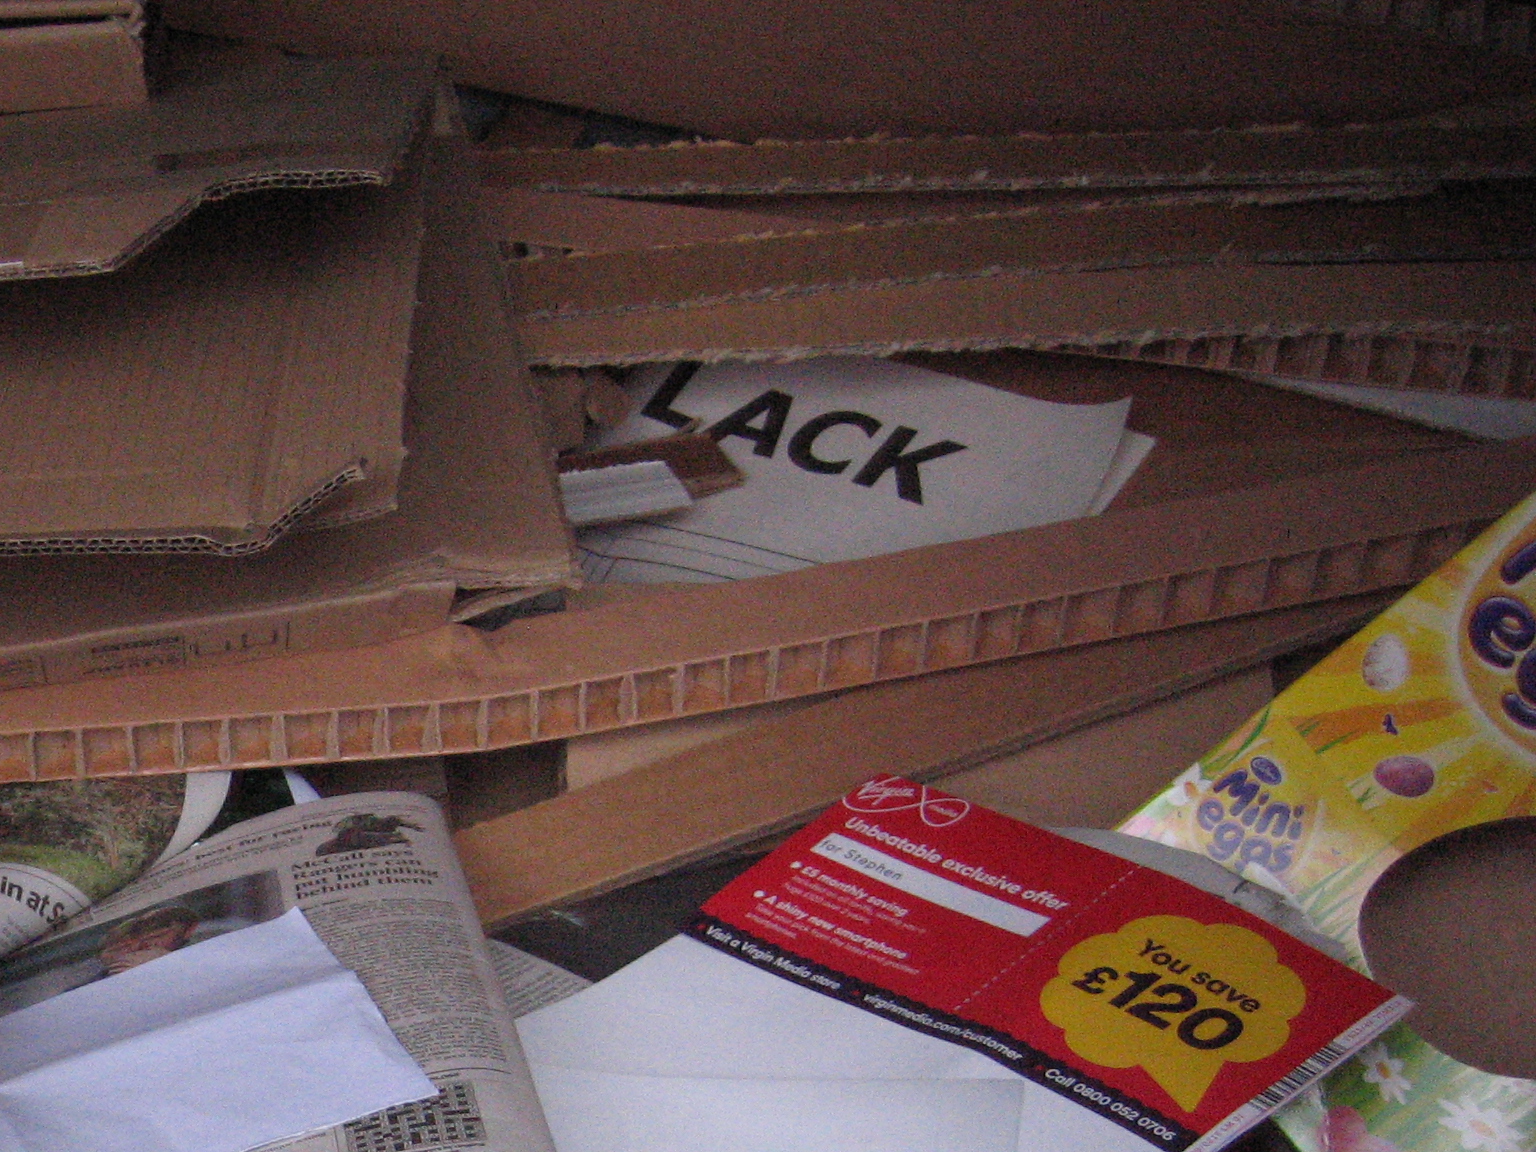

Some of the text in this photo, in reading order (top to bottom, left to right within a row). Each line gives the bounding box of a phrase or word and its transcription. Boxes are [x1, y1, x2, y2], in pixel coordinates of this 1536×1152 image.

[1197, 799, 1295, 872] eggs
[1213, 768, 1305, 840] Mini
[817, 874, 868, 900] monthly
[867, 895, 910, 918] saving
[843, 848, 902, 881] Stephen
[845, 817, 1069, 911] Unbeatable exclusive offer
[776, 901, 908, 960] shiny new smartphone
[1071, 966, 1245, 1051] £120
[1138, 938, 1261, 1014] You save
[706, 925, 732, 944] Visit
[741, 941, 773, 963] Virgin
[773, 955, 811, 980] Media
[810, 971, 840, 991] store
[864, 993, 1024, 1062] virginmedia.com/customer
[1044, 1067, 1075, 1089] Call
[1074, 1081, 1110, 1107] 0800
[1109, 1100, 1139, 1123] 052
[1137, 1115, 1175, 1143] 0706
